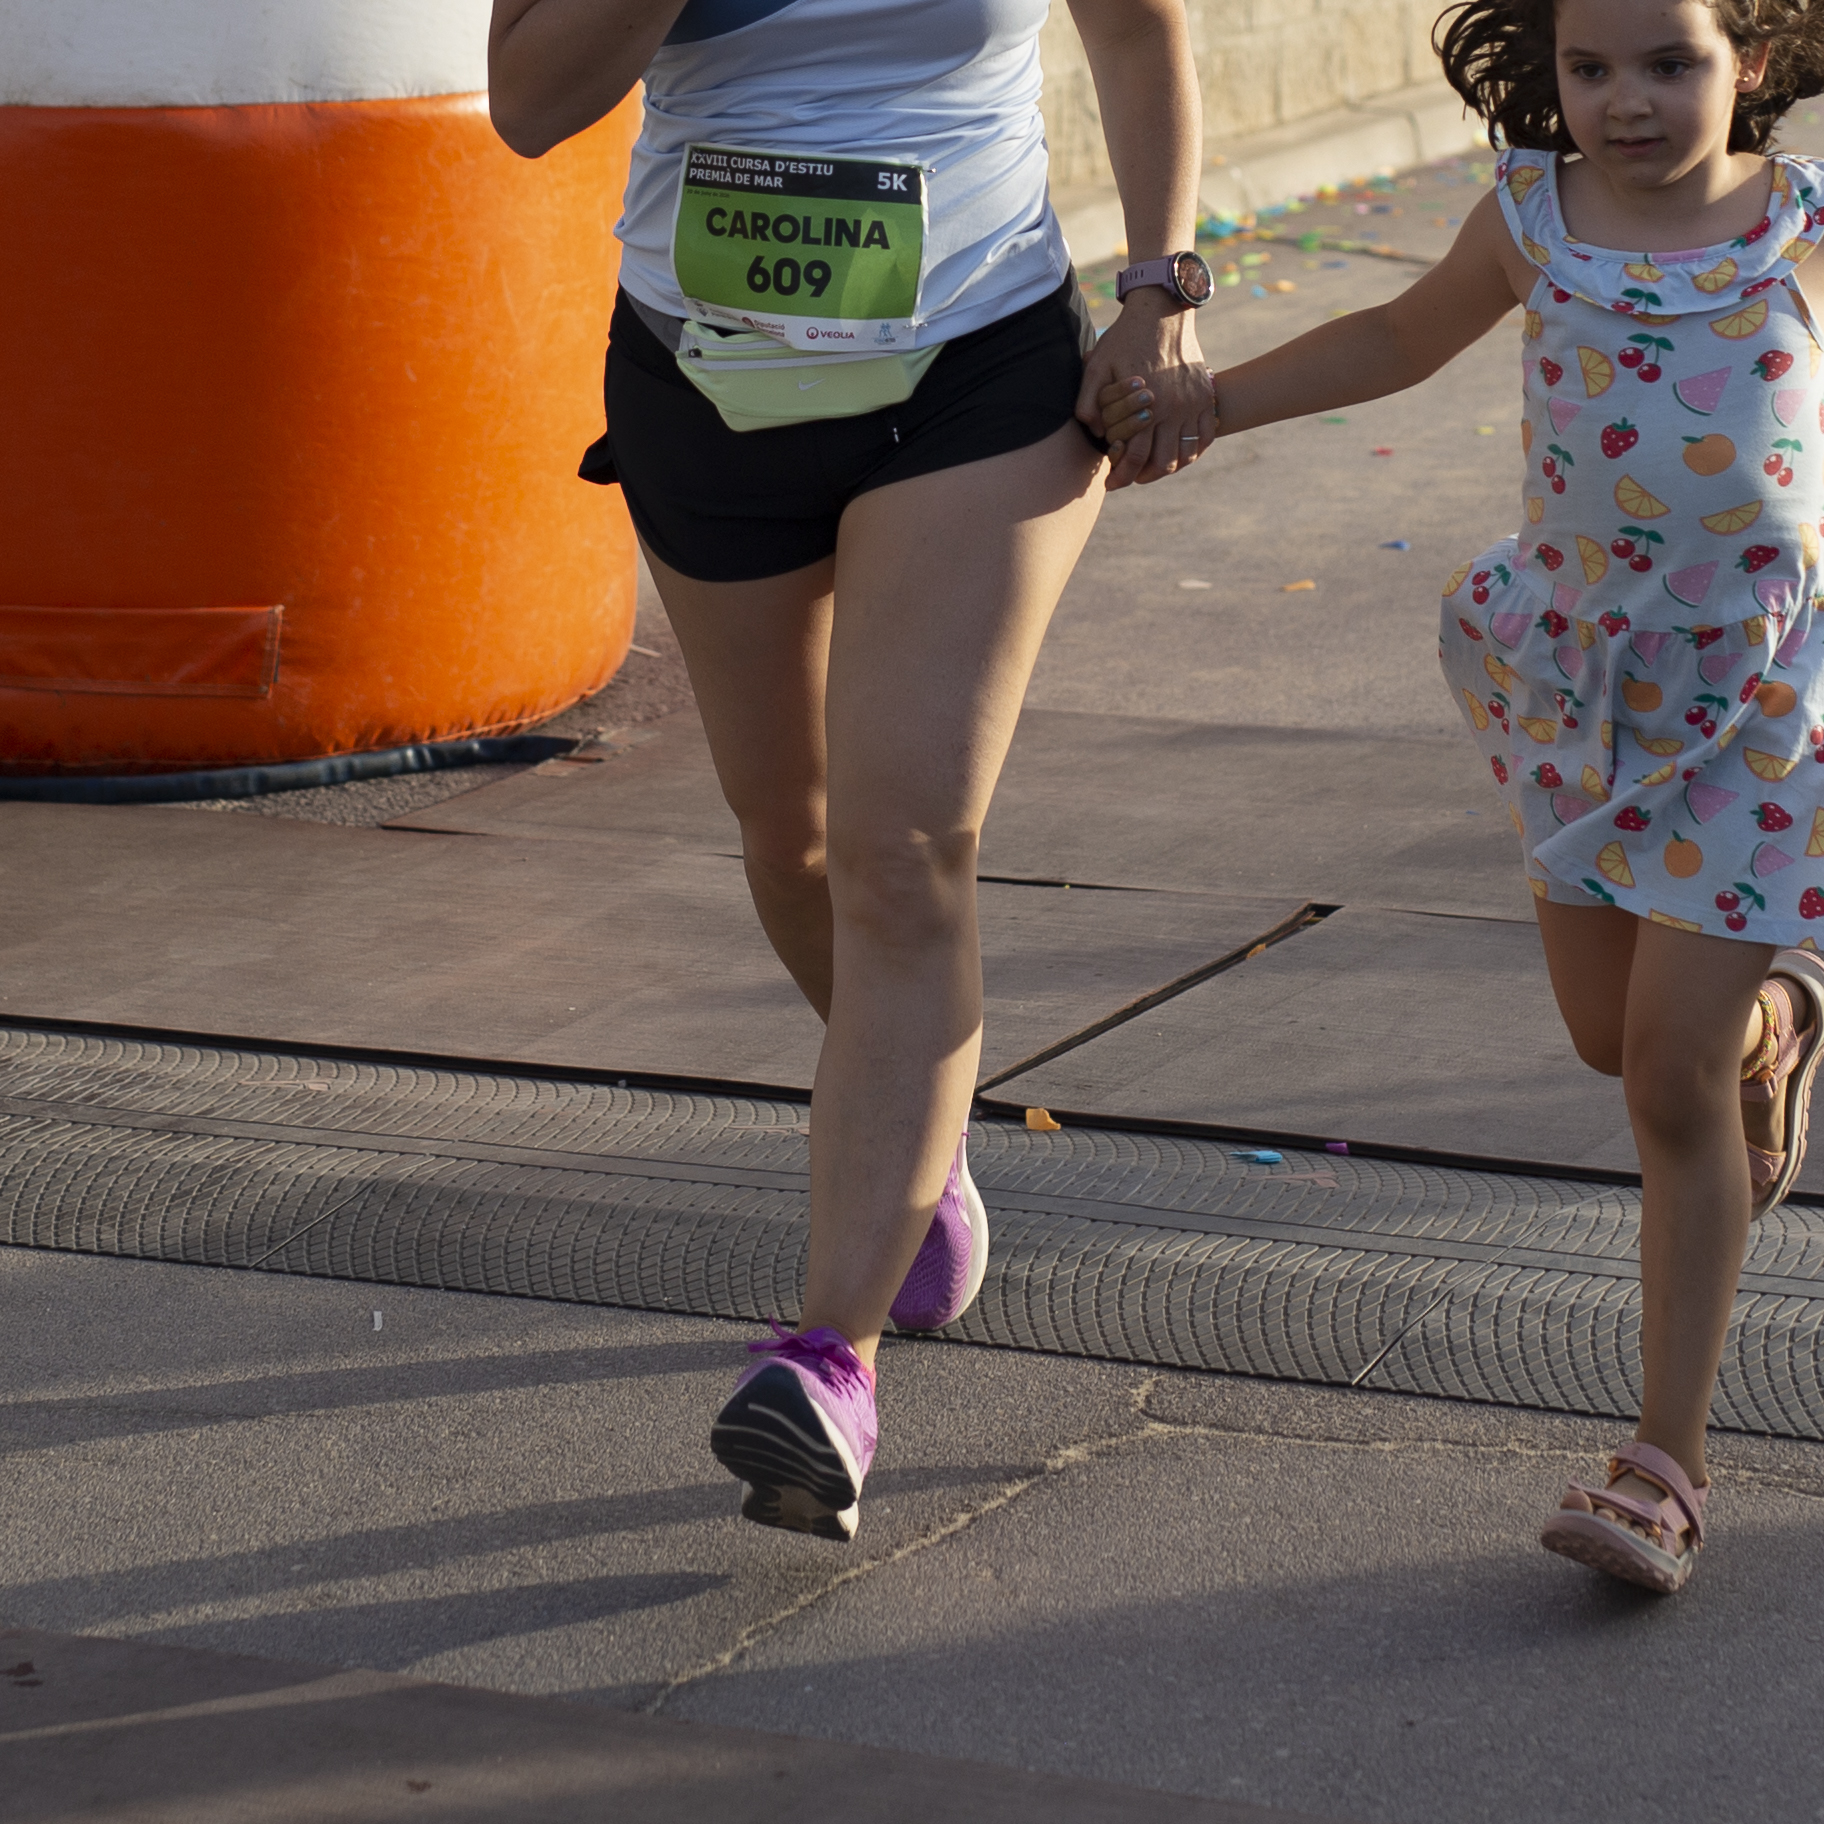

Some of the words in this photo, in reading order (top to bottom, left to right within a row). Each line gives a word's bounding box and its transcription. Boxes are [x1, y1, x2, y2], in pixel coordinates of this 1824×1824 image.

[690, 152, 728, 167] XXVIII
[730, 156, 771, 172] CURSA
[689, 168, 733, 183] PREMIÀ
[734, 173, 751, 185] DE
[753, 175, 784, 189] MAR
[877, 171, 908, 192] 5K
[705, 207, 891, 251] CAROLINA
[746, 255, 832, 298] 609
[821, 330, 855, 340] VEOLIA
